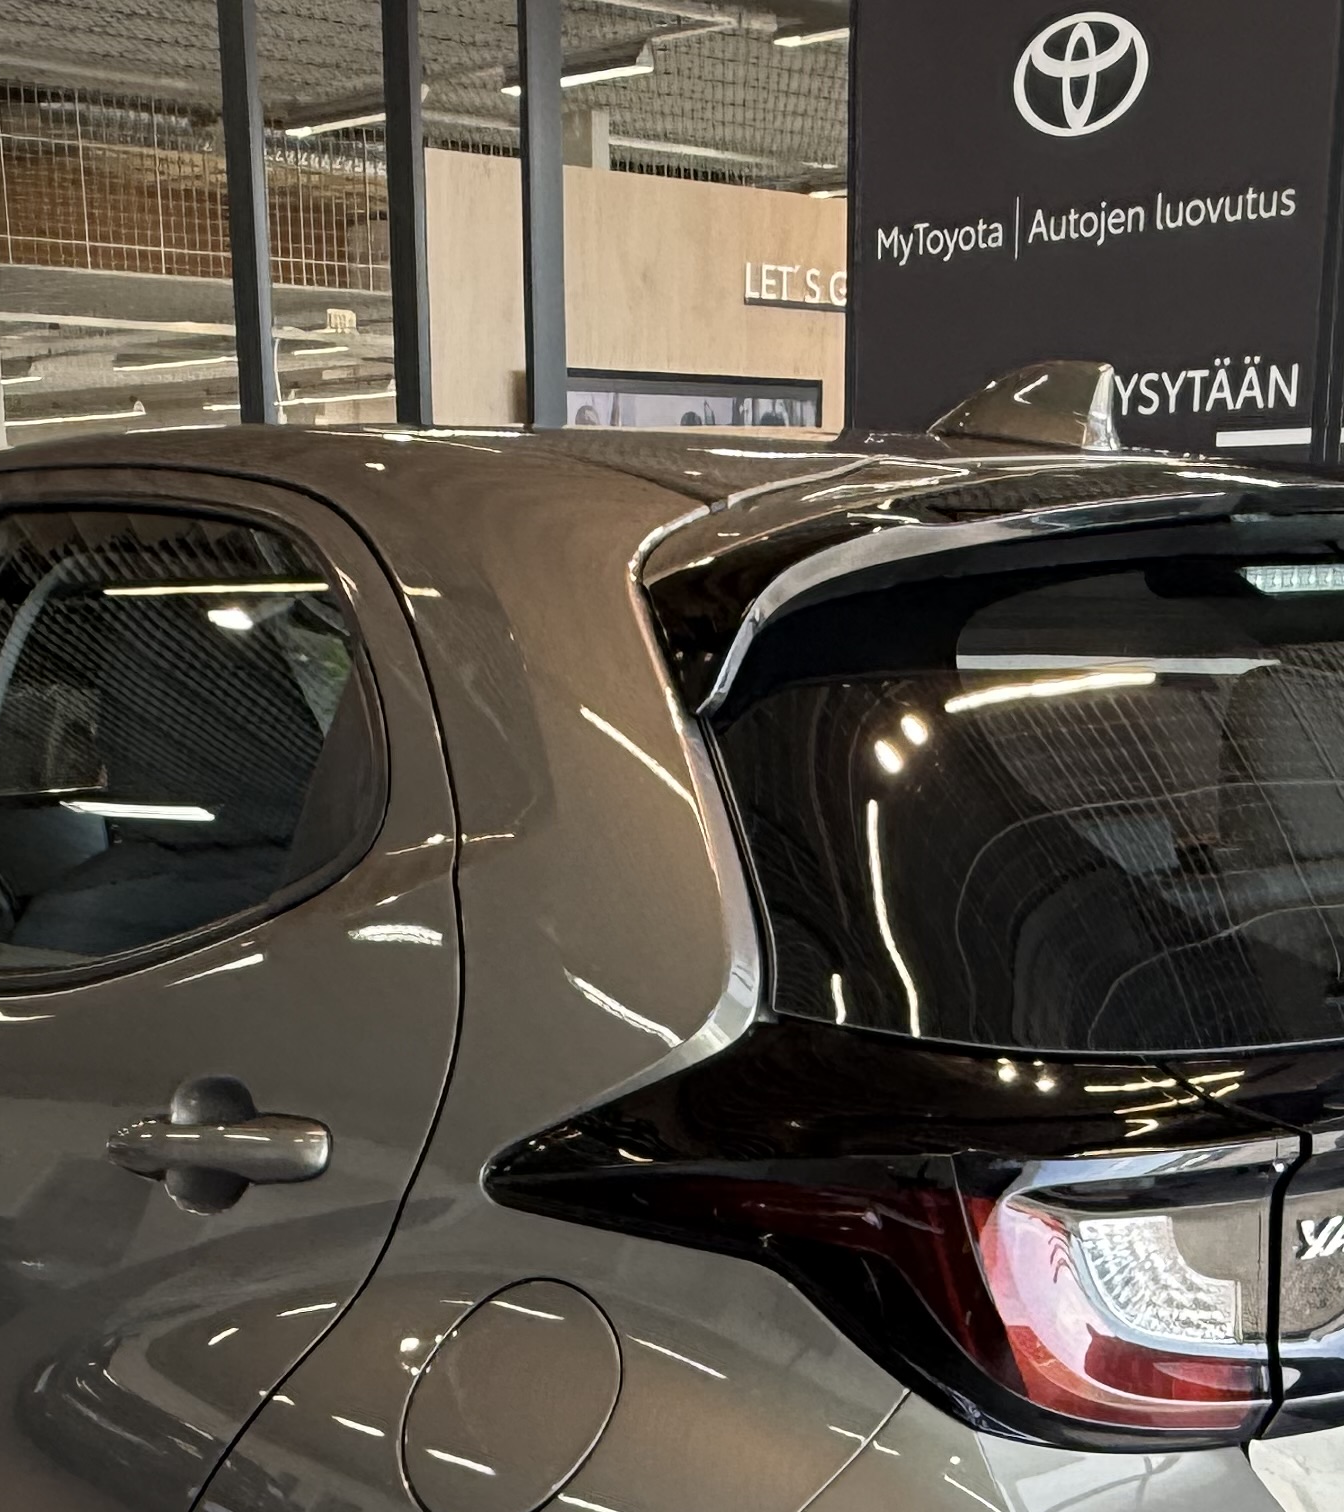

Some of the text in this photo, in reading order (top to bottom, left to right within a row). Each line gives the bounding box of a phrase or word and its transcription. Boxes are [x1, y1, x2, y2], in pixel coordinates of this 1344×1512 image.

[877, 187, 1297, 266] MyToyota Autojen luovutus
[1114, 356, 1299, 416] YSYTÄÄN
